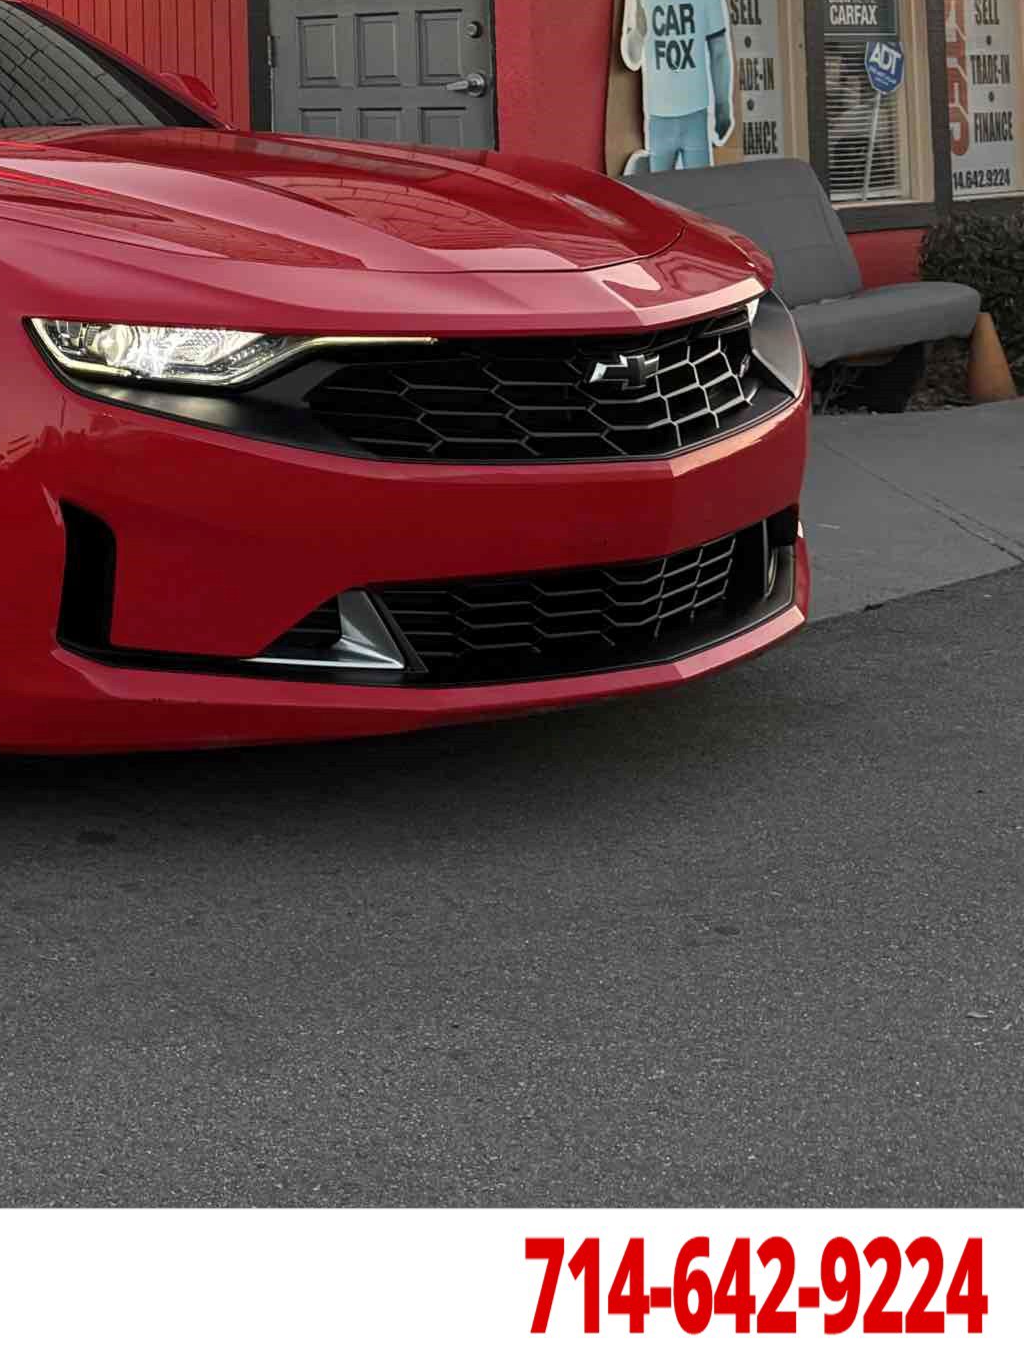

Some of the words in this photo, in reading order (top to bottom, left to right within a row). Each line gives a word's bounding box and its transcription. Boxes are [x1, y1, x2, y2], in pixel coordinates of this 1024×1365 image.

[652, 3, 696, 36] CAR
[830, 4, 878, 26] CARFAX
[654, 38, 696, 70] FOX
[869, 41, 902, 75] ADT
[970, 55, 1011, 85] TRADE-IN
[739, 58, 775, 91] ADE-IN
[974, 111, 1013, 144] FINANCE
